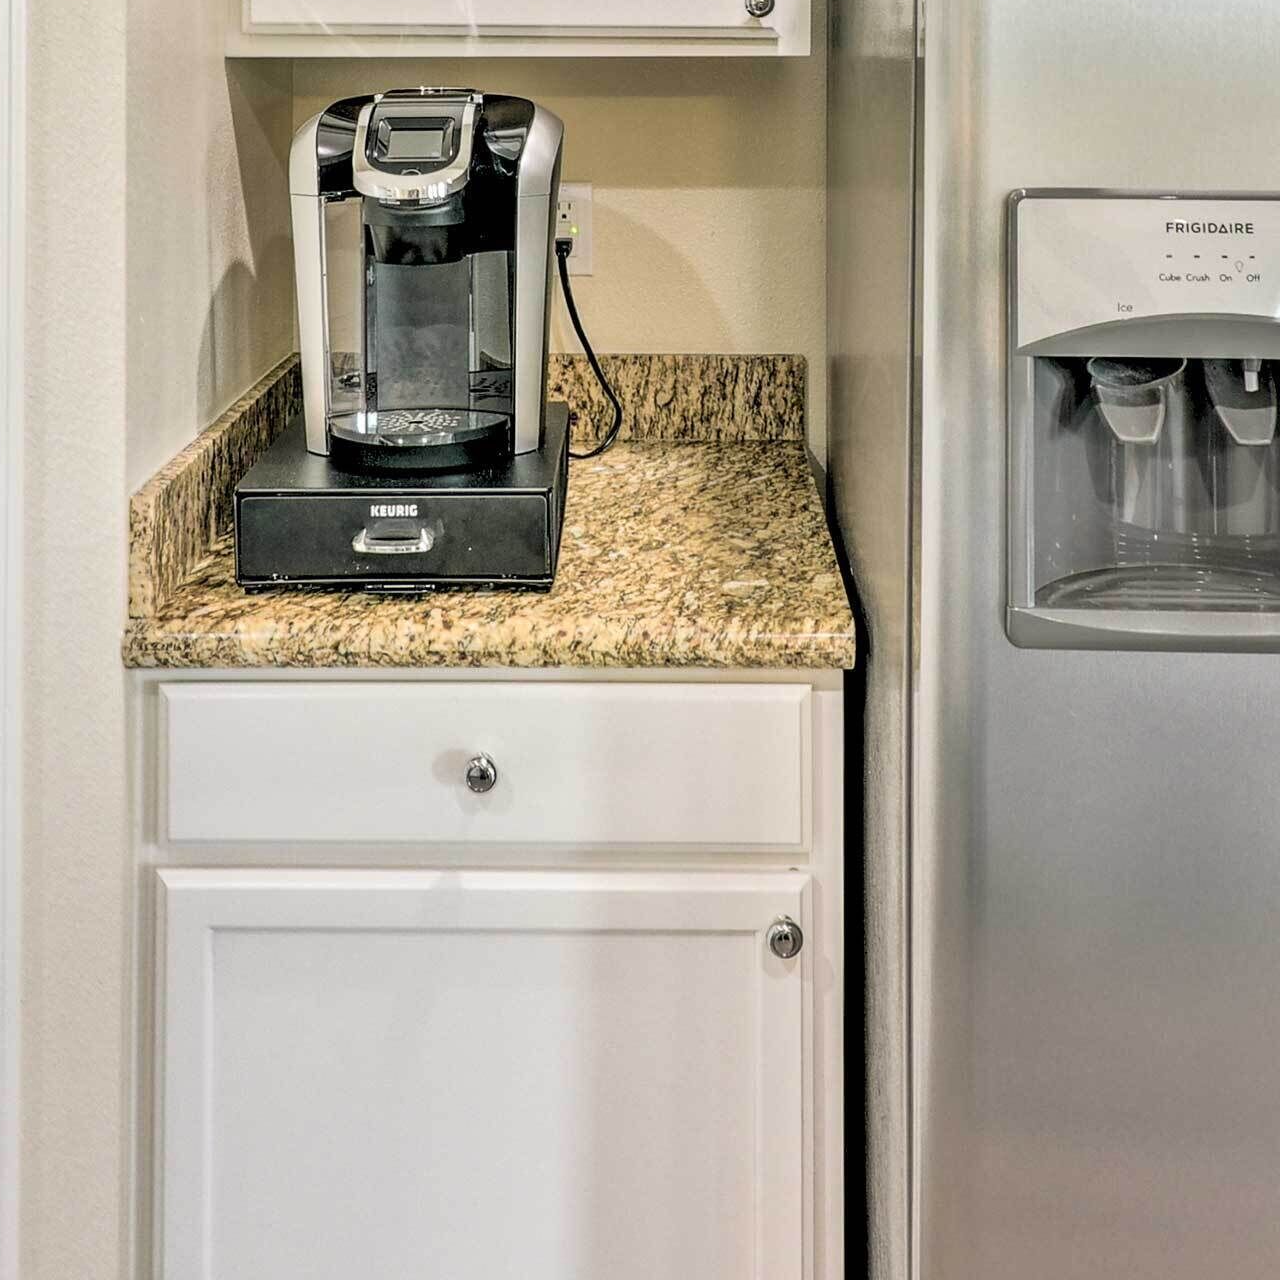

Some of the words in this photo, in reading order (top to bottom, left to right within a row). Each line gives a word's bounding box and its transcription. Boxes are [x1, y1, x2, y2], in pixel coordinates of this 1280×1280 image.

[1165, 221, 1255, 235] FRIGIDAIRE
[1158, 272, 1182, 283] Cube
[1185, 272, 1211, 283] Crush
[1218, 272, 1233, 283] On
[1245, 272, 1261, 283] Off
[1117, 301, 1134, 313] Ice
[370, 504, 419, 518] KEURIG
